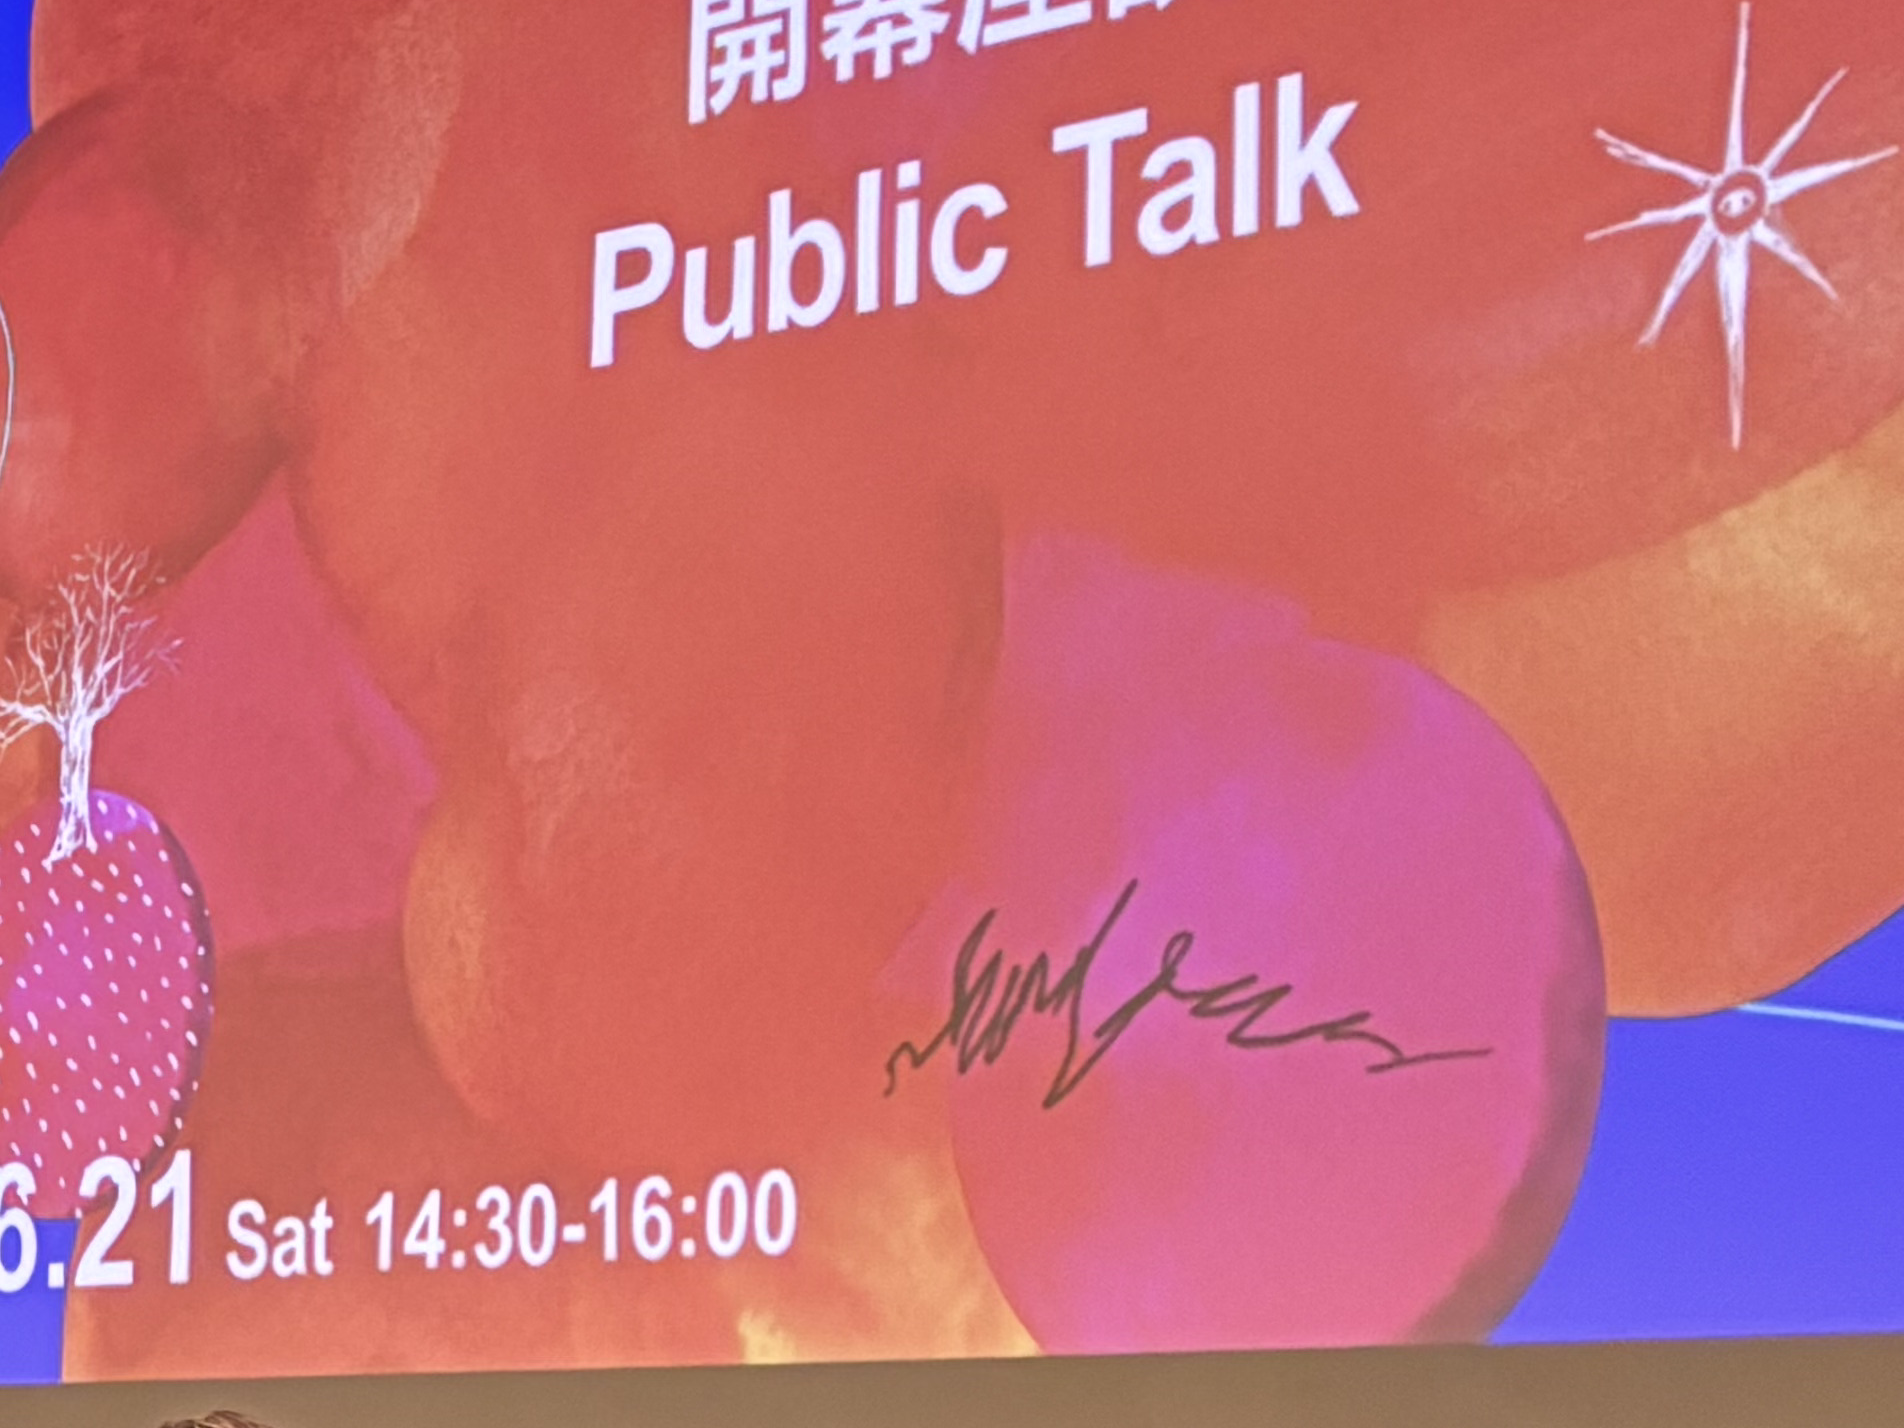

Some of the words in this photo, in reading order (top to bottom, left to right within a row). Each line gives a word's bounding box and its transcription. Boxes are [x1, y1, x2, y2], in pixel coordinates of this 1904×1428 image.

[590, 159, 1008, 369] Public
[1052, 71, 1361, 268] Talk
[225, 1197, 335, 1281] Sat
[365, 1168, 799, 1272] 14:30-16:00
